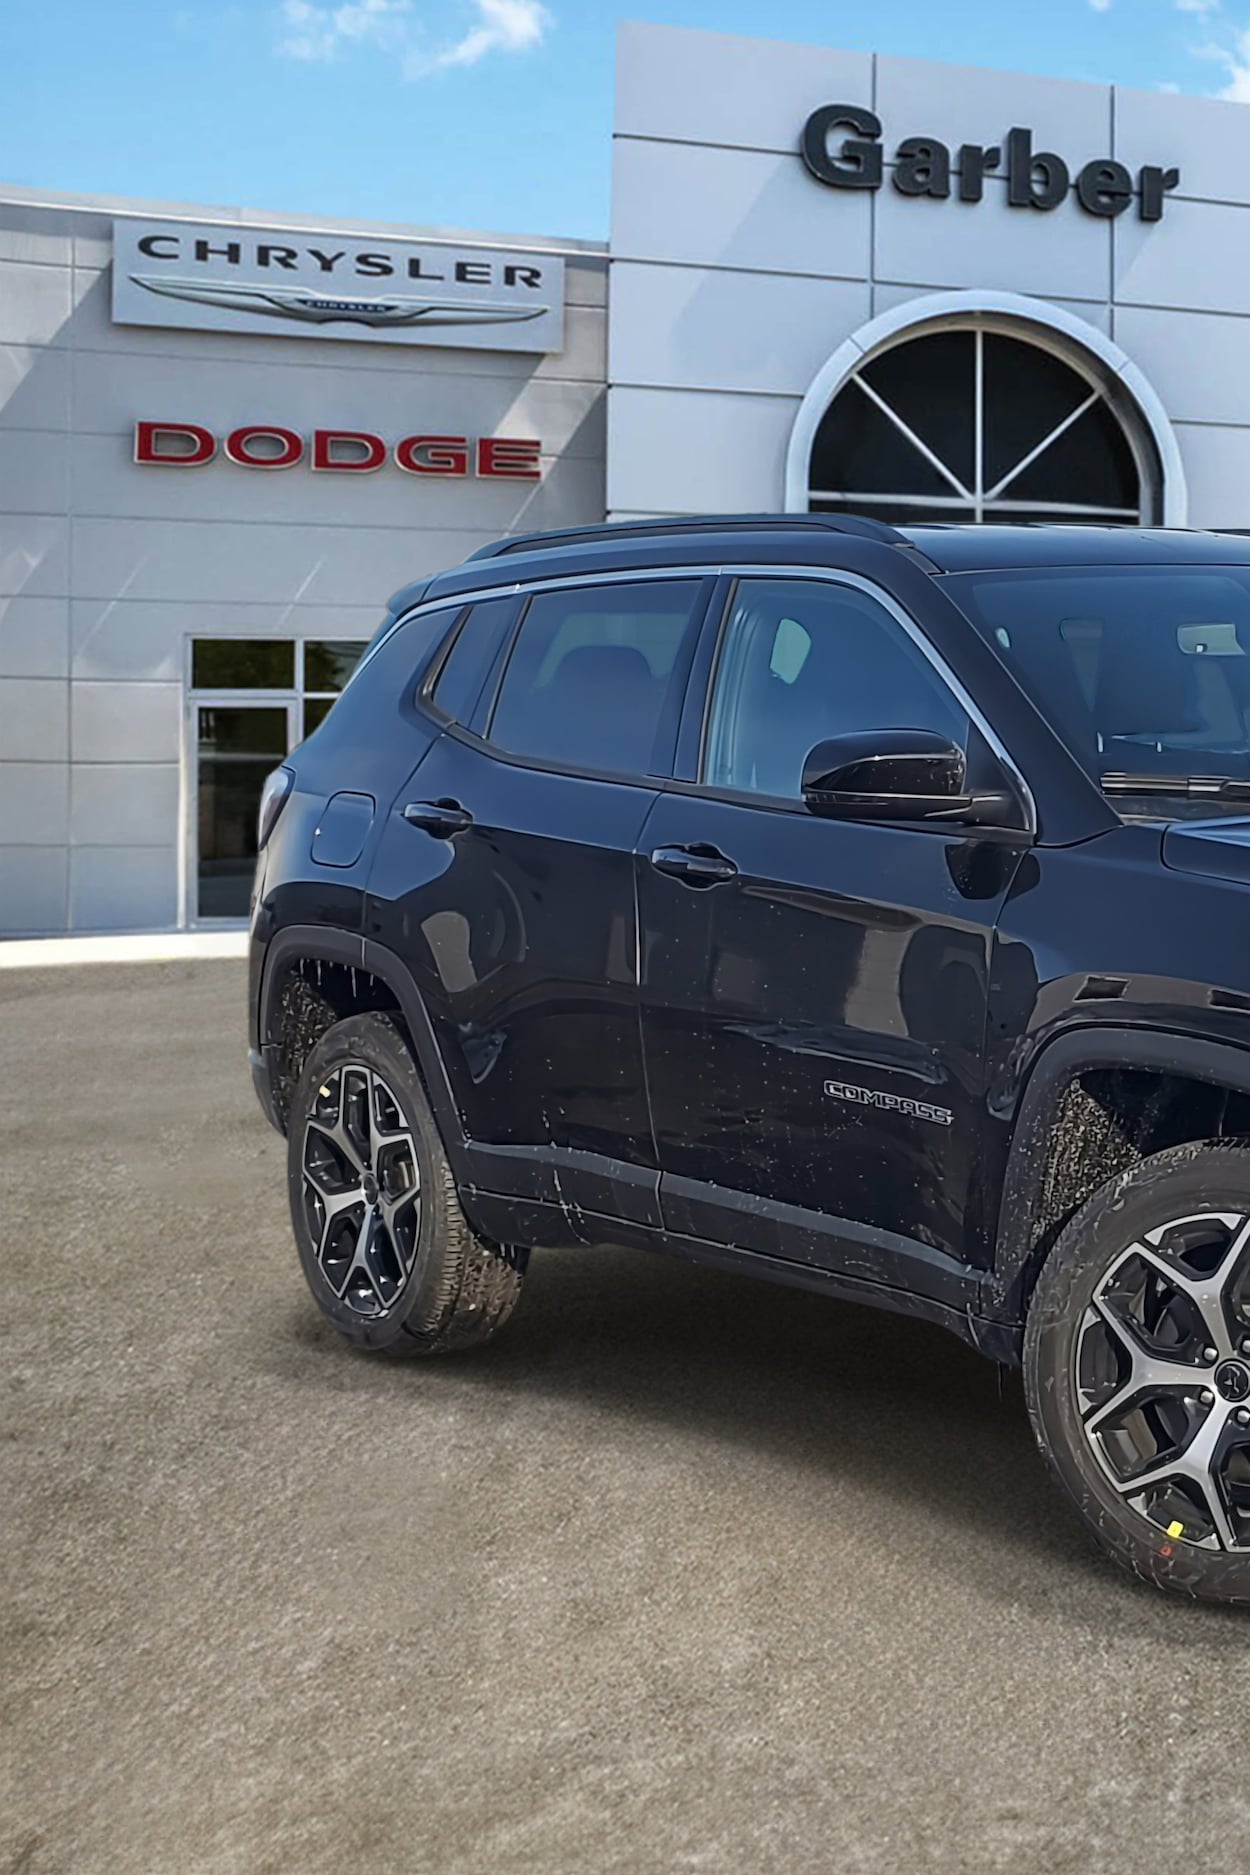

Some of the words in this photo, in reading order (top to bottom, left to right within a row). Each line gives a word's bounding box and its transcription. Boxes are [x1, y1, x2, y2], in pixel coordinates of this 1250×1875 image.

[803, 104, 1179, 222] Garber
[137, 235, 542, 289] CHRYSLER
[134, 421, 542, 480] DODGE
[823, 1080, 954, 1126] COMPASS
